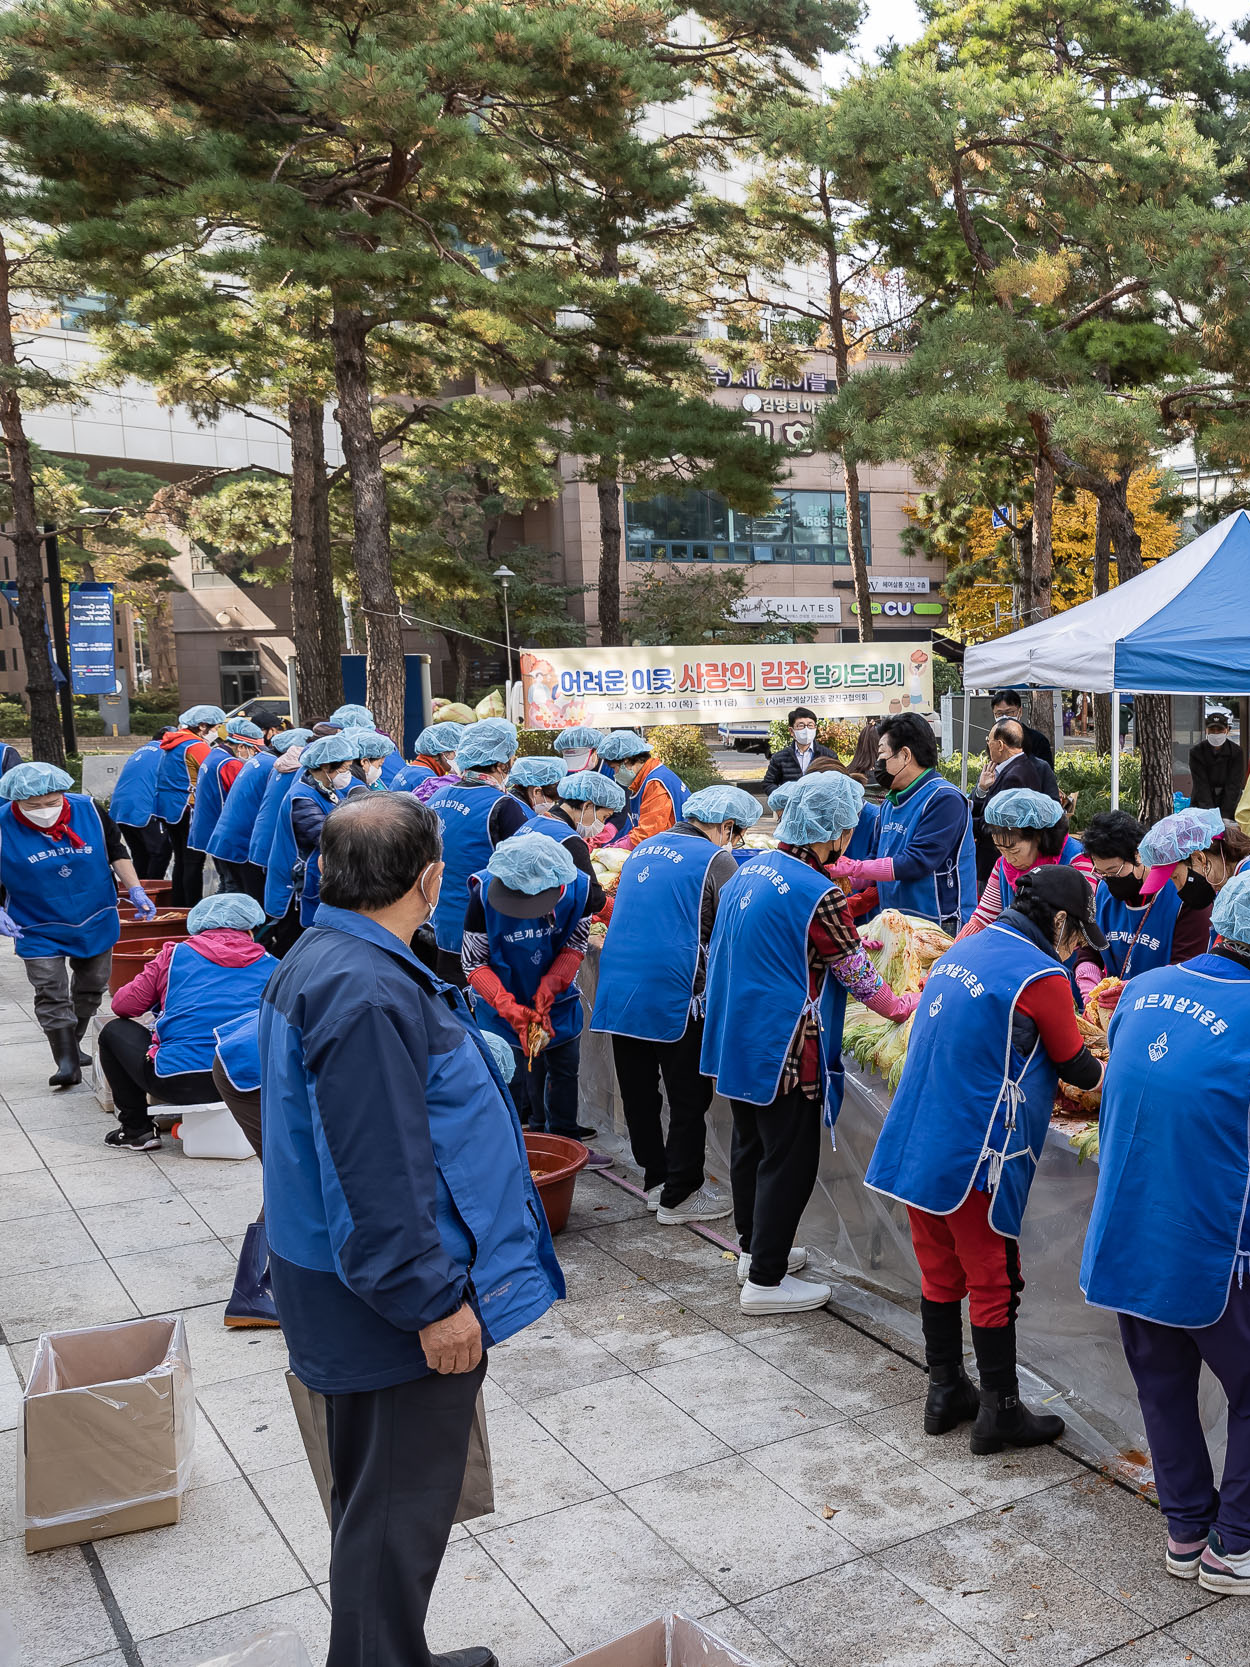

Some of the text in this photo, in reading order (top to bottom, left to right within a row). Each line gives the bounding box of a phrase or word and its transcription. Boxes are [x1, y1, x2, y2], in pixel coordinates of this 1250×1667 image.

[707, 366, 733, 387] 주)
[762, 397, 800, 413] 김명희
[777, 604, 834, 612] PILATES
[884, 601, 912, 616] CU
[560, 660, 904, 694] 어려운 이웃 사랑의 김장 담가드리기
[606, 702, 623, 711] 일시
[741, 864, 791, 895] 바르게살기운동
[930, 963, 985, 998] 바르게살기운동
[1133, 993, 1229, 1036] 바르게살기운동
